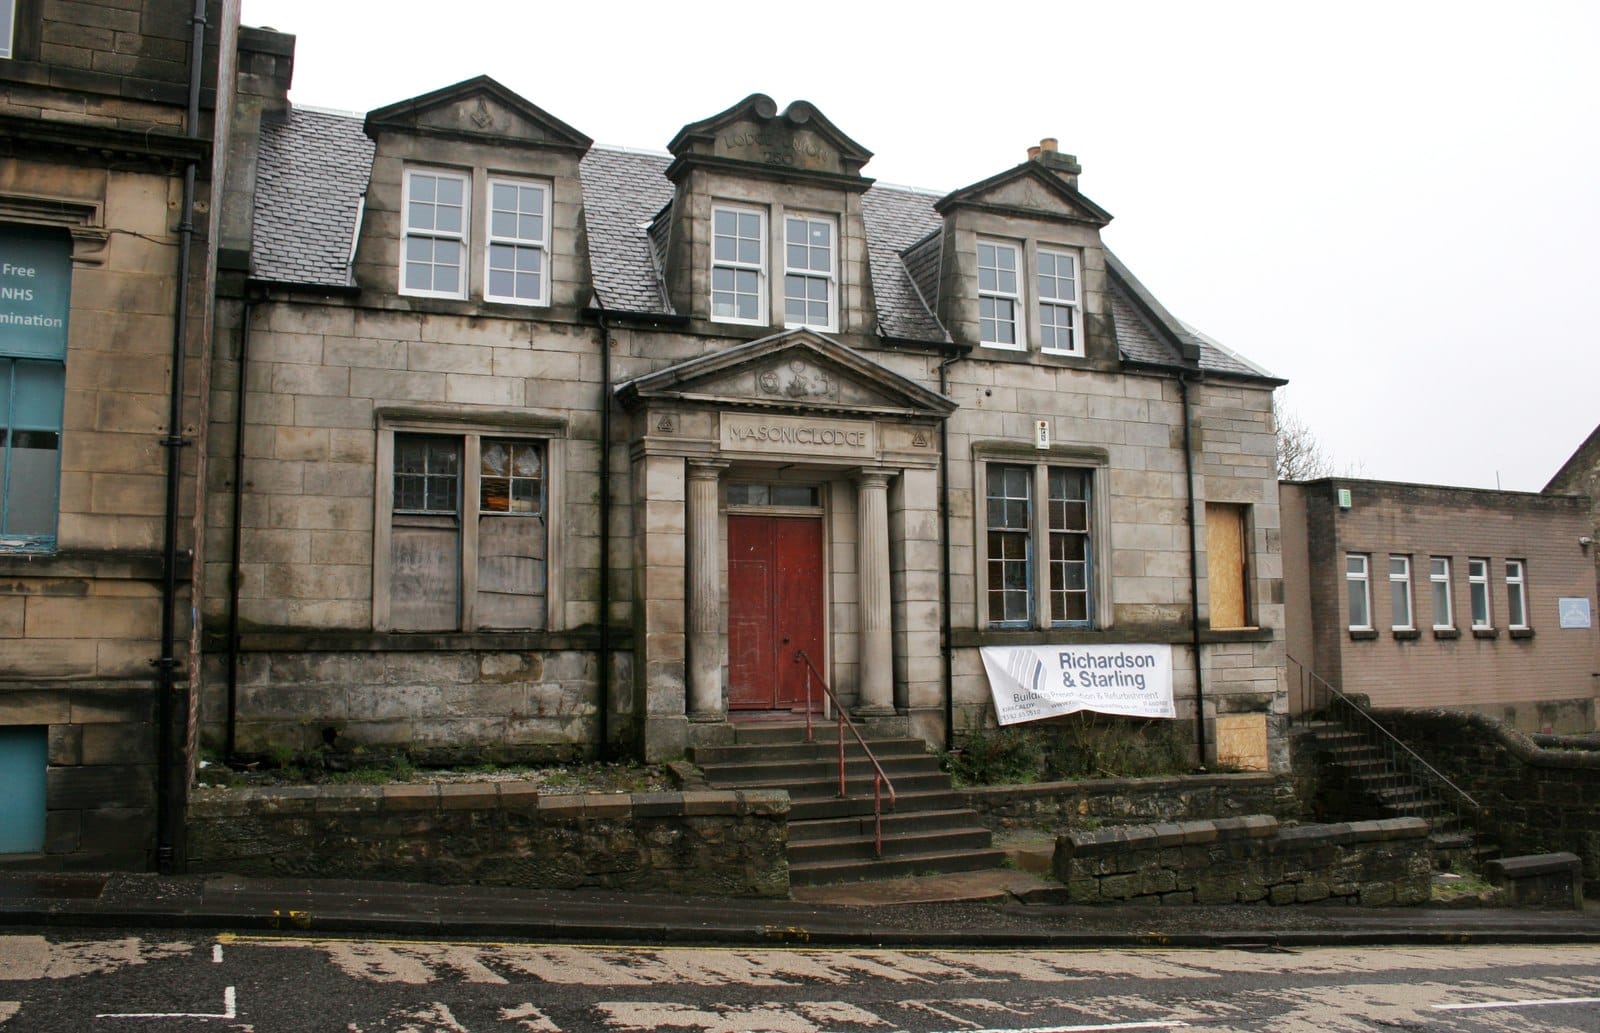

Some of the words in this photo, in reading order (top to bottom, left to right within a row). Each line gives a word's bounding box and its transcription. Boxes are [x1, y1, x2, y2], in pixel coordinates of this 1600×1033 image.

[2, 263, 36, 277] Free
[1, 287, 34, 301] NHS
[729, 424, 811, 444] MASONIC
[812, 428, 866, 447] LODGE
[1059, 652, 1155, 669] Richardson
[1062, 672, 1076, 687] &
[1079, 670, 1146, 690] Starling
